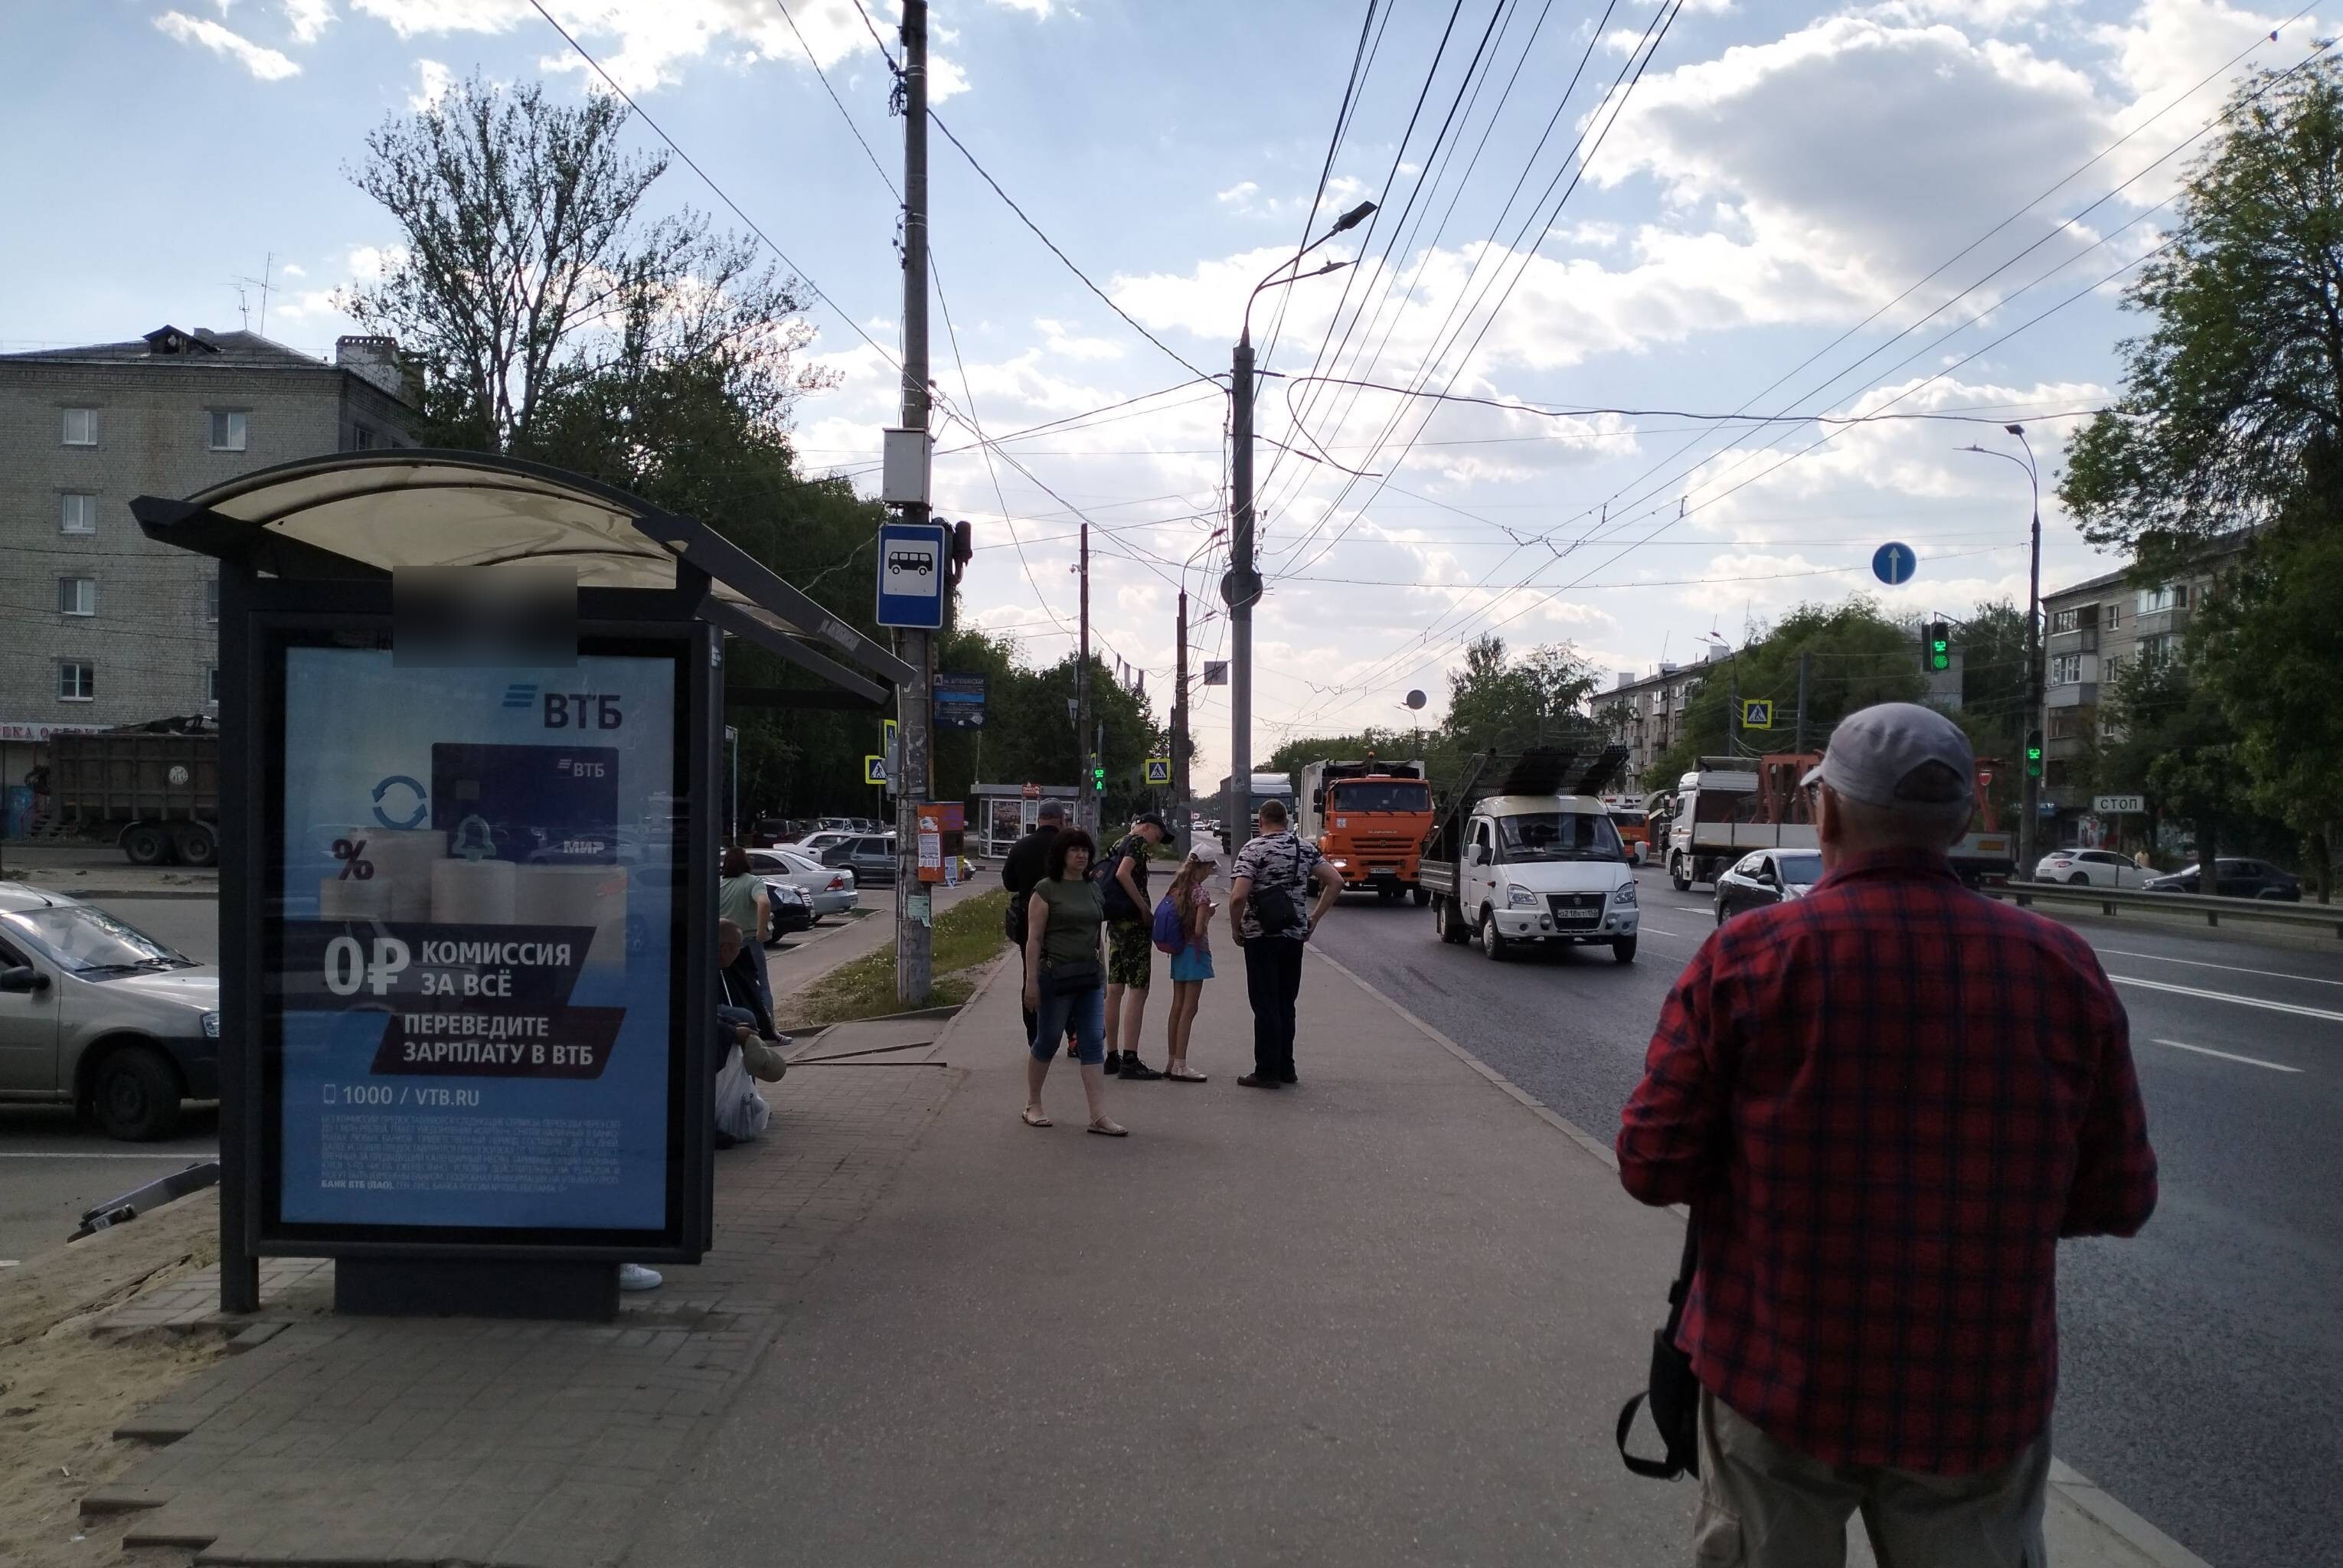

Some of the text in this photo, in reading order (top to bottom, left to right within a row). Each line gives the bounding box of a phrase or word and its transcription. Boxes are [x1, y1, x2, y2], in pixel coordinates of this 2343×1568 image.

[544, 693, 623, 729] ВТБ
[573, 762, 605, 778] ВТБ
[2100, 798, 2138, 810] СТОП
[563, 840, 605, 854] МИР
[422, 941, 571, 967] КОМИССИЯ
[420, 969, 512, 997] ЗА ВСЁ
[404, 1014, 550, 1040] ПЕРЕВЕДИТЕ
[403, 1042, 593, 1065] ЗАРПЛАТУ В ВТБ
[342, 1086, 393, 1105] 1000
[415, 1088, 479, 1106] VTB.RU
[321, 1180, 346, 1188] БАНК
[348, 1180, 366, 1189] ВТБ
